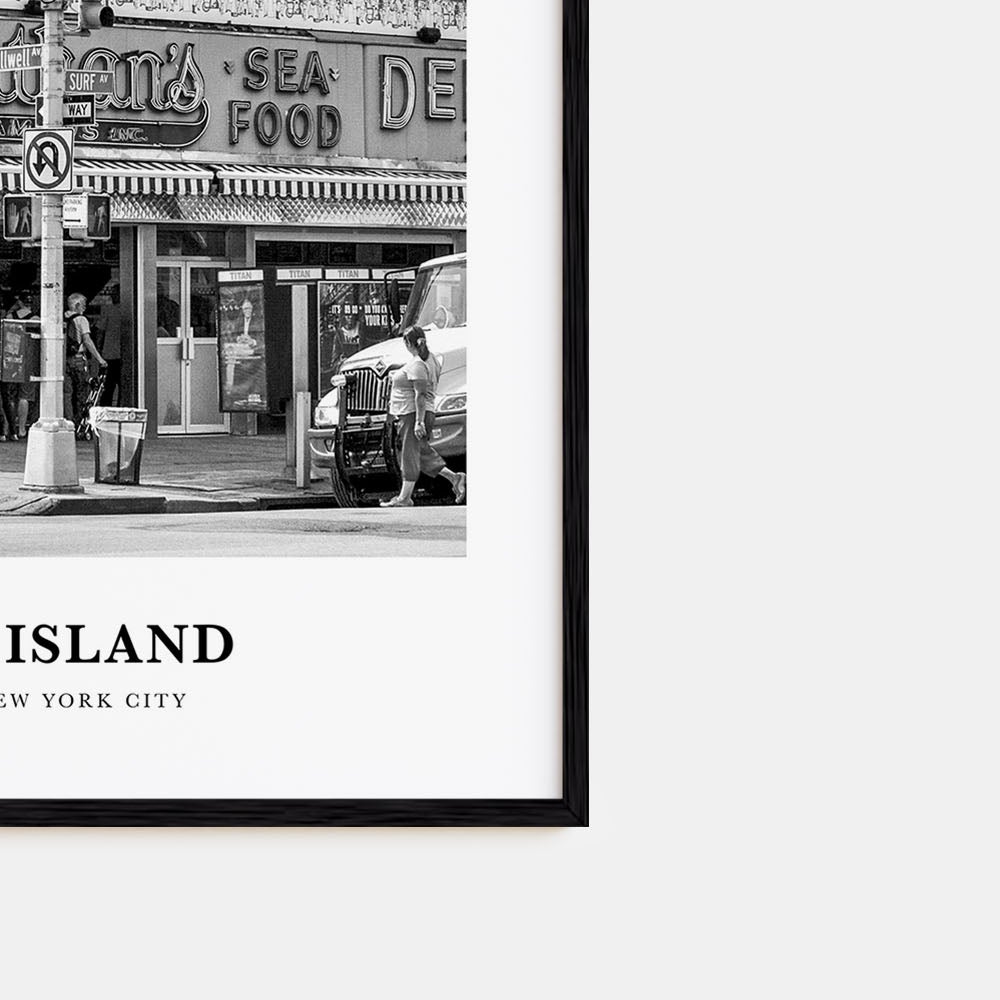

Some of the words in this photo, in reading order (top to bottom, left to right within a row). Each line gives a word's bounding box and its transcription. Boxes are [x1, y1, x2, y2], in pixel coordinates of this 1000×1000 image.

[243, 47, 330, 96] SEA
[69, 73, 96, 91] SURF
[99, 74, 109, 83] AV
[68, 103, 88, 116] WAY
[229, 100, 342, 148] FOOD
[229, 271, 252, 281] TITAN
[289, 270, 311, 279] TITAN
[338, 270, 359, 279] TITAN
